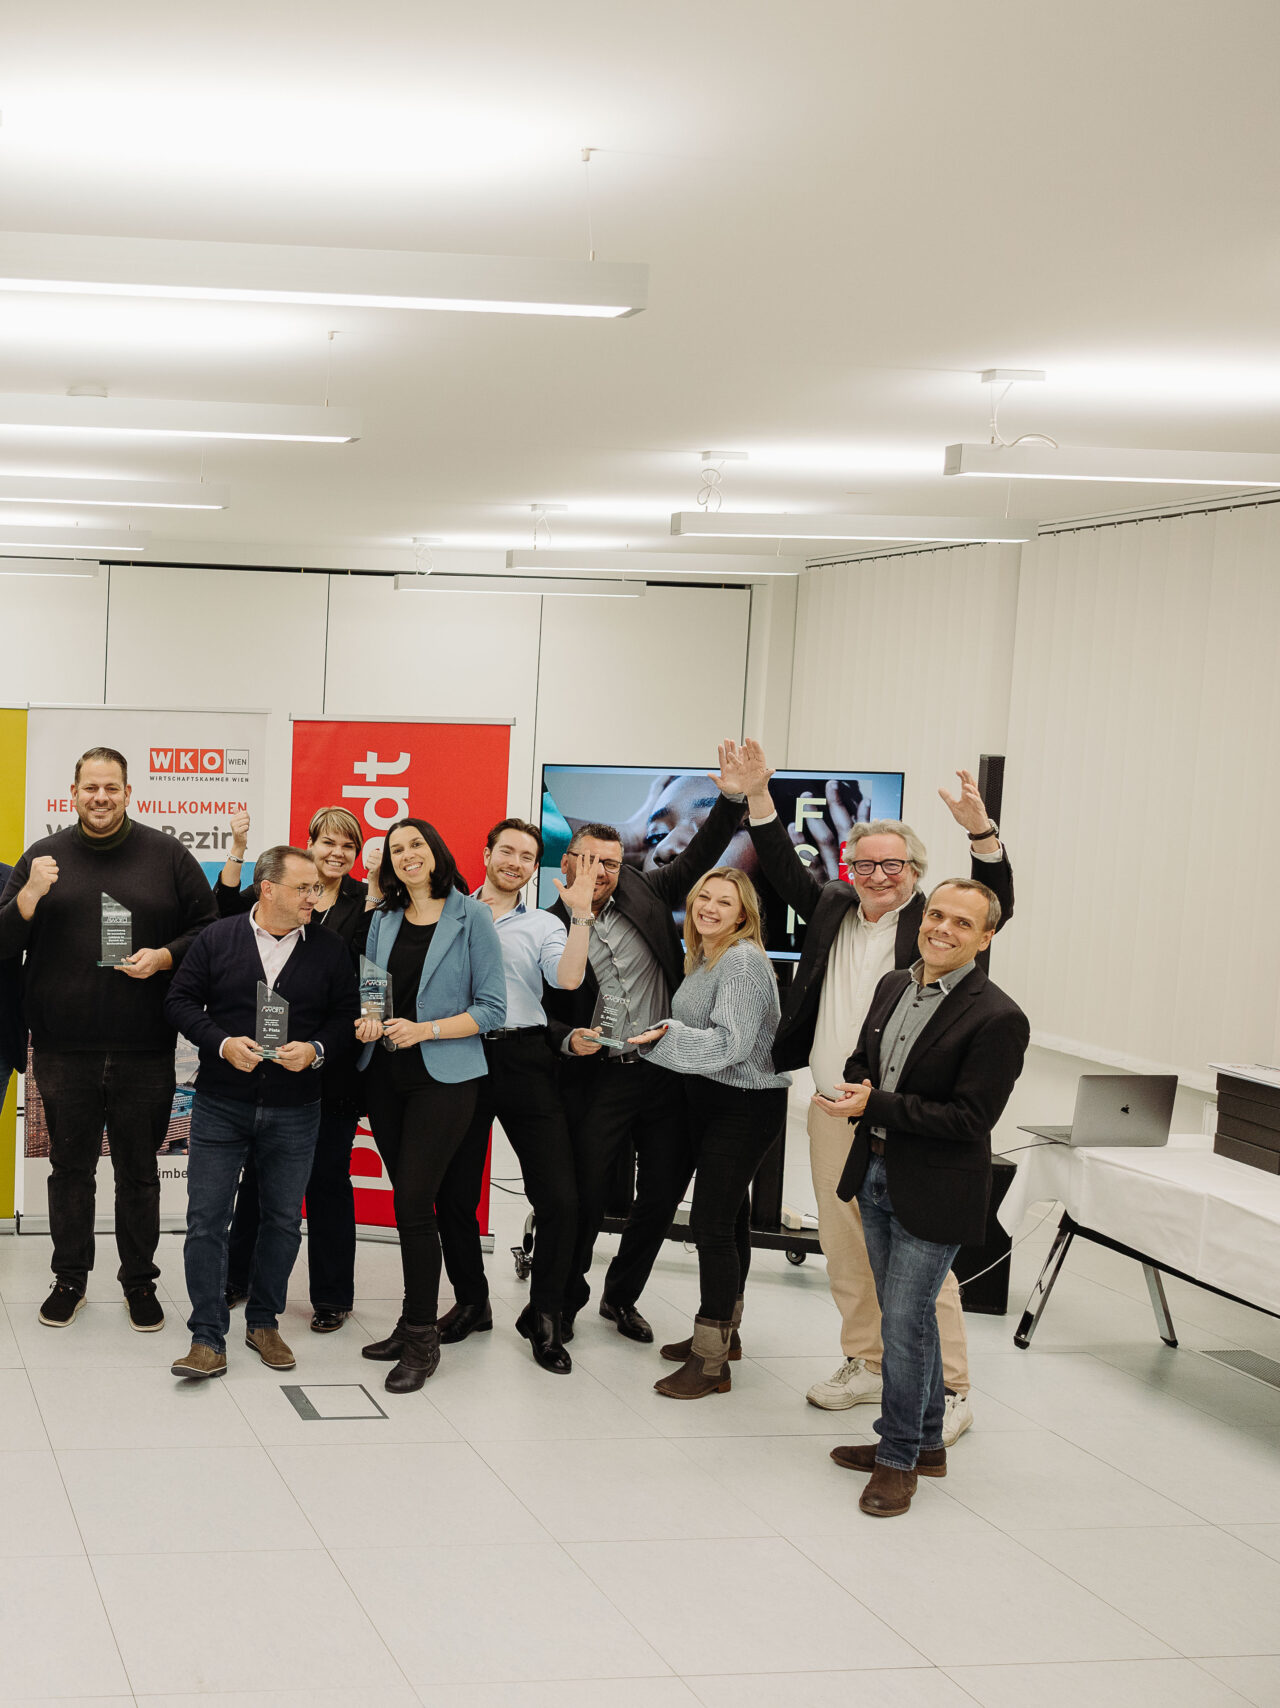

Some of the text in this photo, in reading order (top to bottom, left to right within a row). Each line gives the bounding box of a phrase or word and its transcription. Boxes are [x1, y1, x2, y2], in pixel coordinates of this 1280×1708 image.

[151, 751, 248, 771] WKO WIEN
[136, 801, 248, 814] WILLKOMMEN
